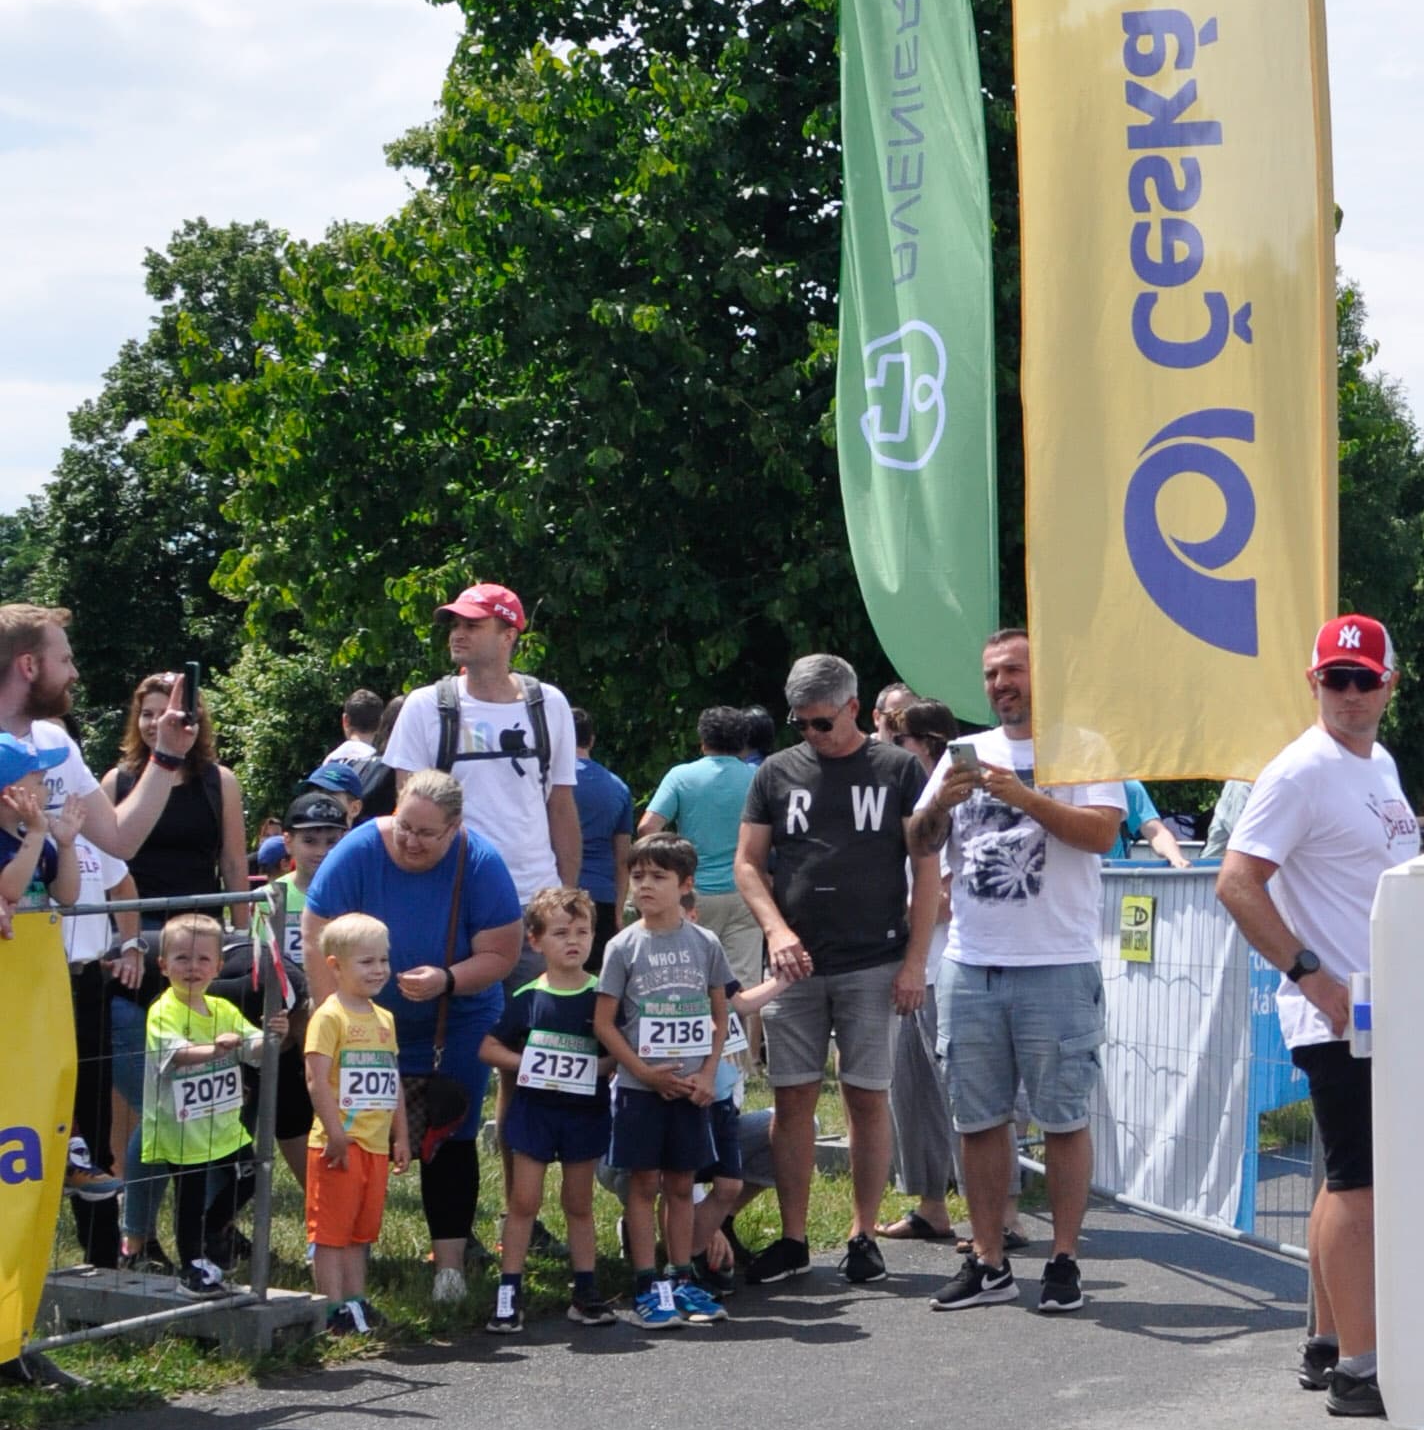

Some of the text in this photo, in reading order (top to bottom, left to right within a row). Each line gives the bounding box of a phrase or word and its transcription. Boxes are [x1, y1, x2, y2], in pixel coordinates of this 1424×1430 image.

[647, 950, 691, 968] WHO IS
[649, 1019, 705, 1044] 2136
[530, 1051, 589, 1080] 2137
[181, 1071, 237, 1106] 2079
[348, 1071, 397, 1095] 2076
